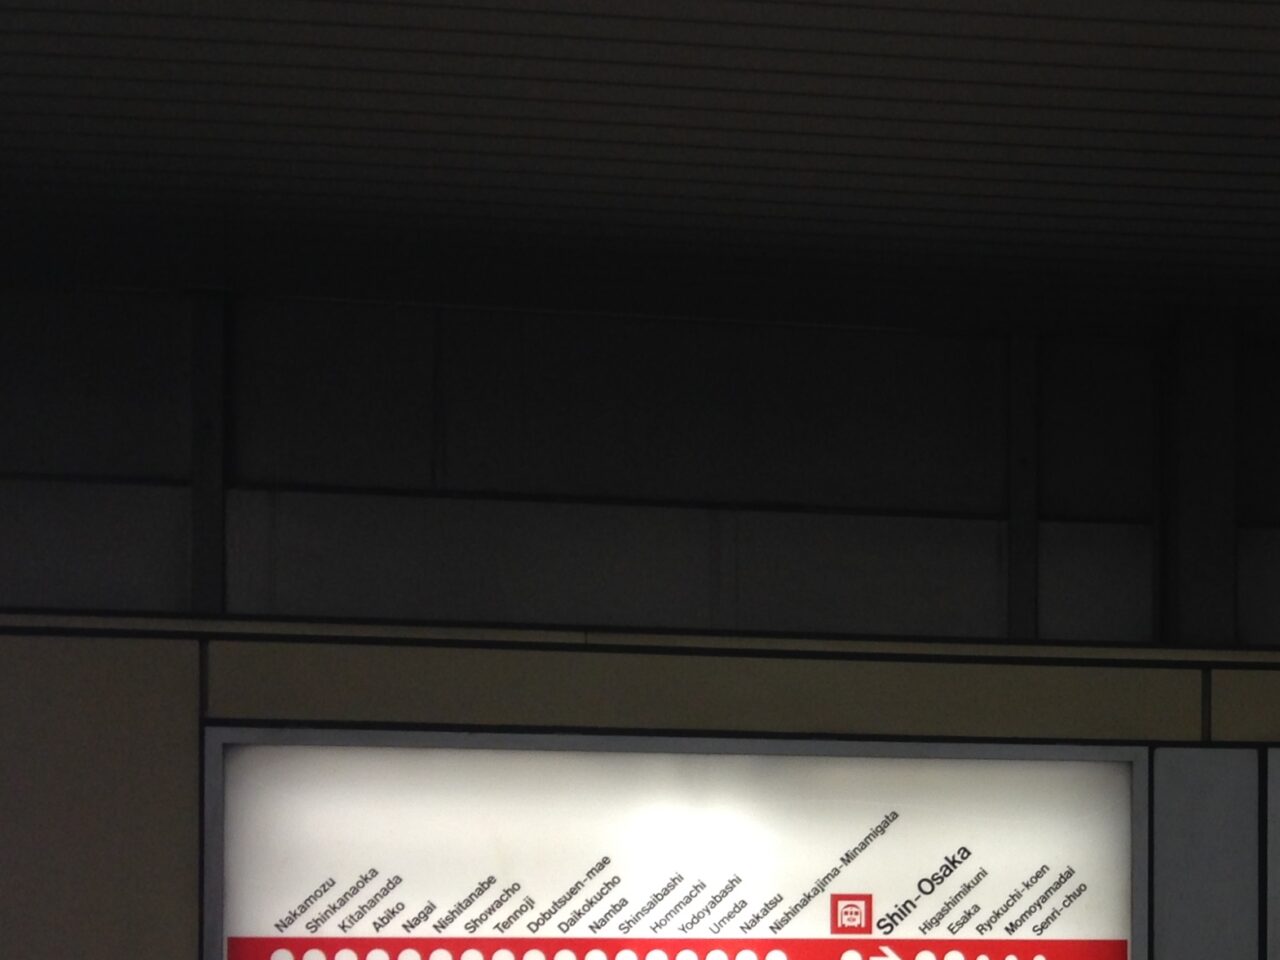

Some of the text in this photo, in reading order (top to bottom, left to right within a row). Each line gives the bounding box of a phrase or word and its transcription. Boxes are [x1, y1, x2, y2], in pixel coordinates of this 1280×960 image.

[305, 866, 379, 934] Shinkanaoka
[526, 855, 611, 934] Dobutsuen-mae
[769, 809, 899, 935] Nishinakajima-Minamigata
[876, 845, 973, 936] Shin-Osaka
[918, 867, 988, 936] Higashimikuni
[975, 863, 1051, 936] Ryokuchi-koen
[1004, 865, 1077, 936] Momoyamadai
[274, 876, 336, 934] Nakamozu
[337, 873, 403, 934] Kitahanada
[373, 901, 405, 933] Abiko
[402, 900, 437, 934] Nagai
[432, 874, 497, 934] Nishitanabe
[464, 881, 521, 934] Showacho
[493, 896, 536, 934] Tennoji
[557, 874, 621, 934] Daikokucho
[588, 897, 629, 934] Namba
[618, 872, 684, 934] Shinsaibashi
[649, 879, 707, 934] Hommachi
[678, 874, 742, 934] Yodoyabashi
[708, 898, 748, 934] Umeda
[739, 892, 784, 934] Nakatsu
[947, 902, 981, 936] Esaka
[1032, 881, 1087, 936] Senri-chuo
